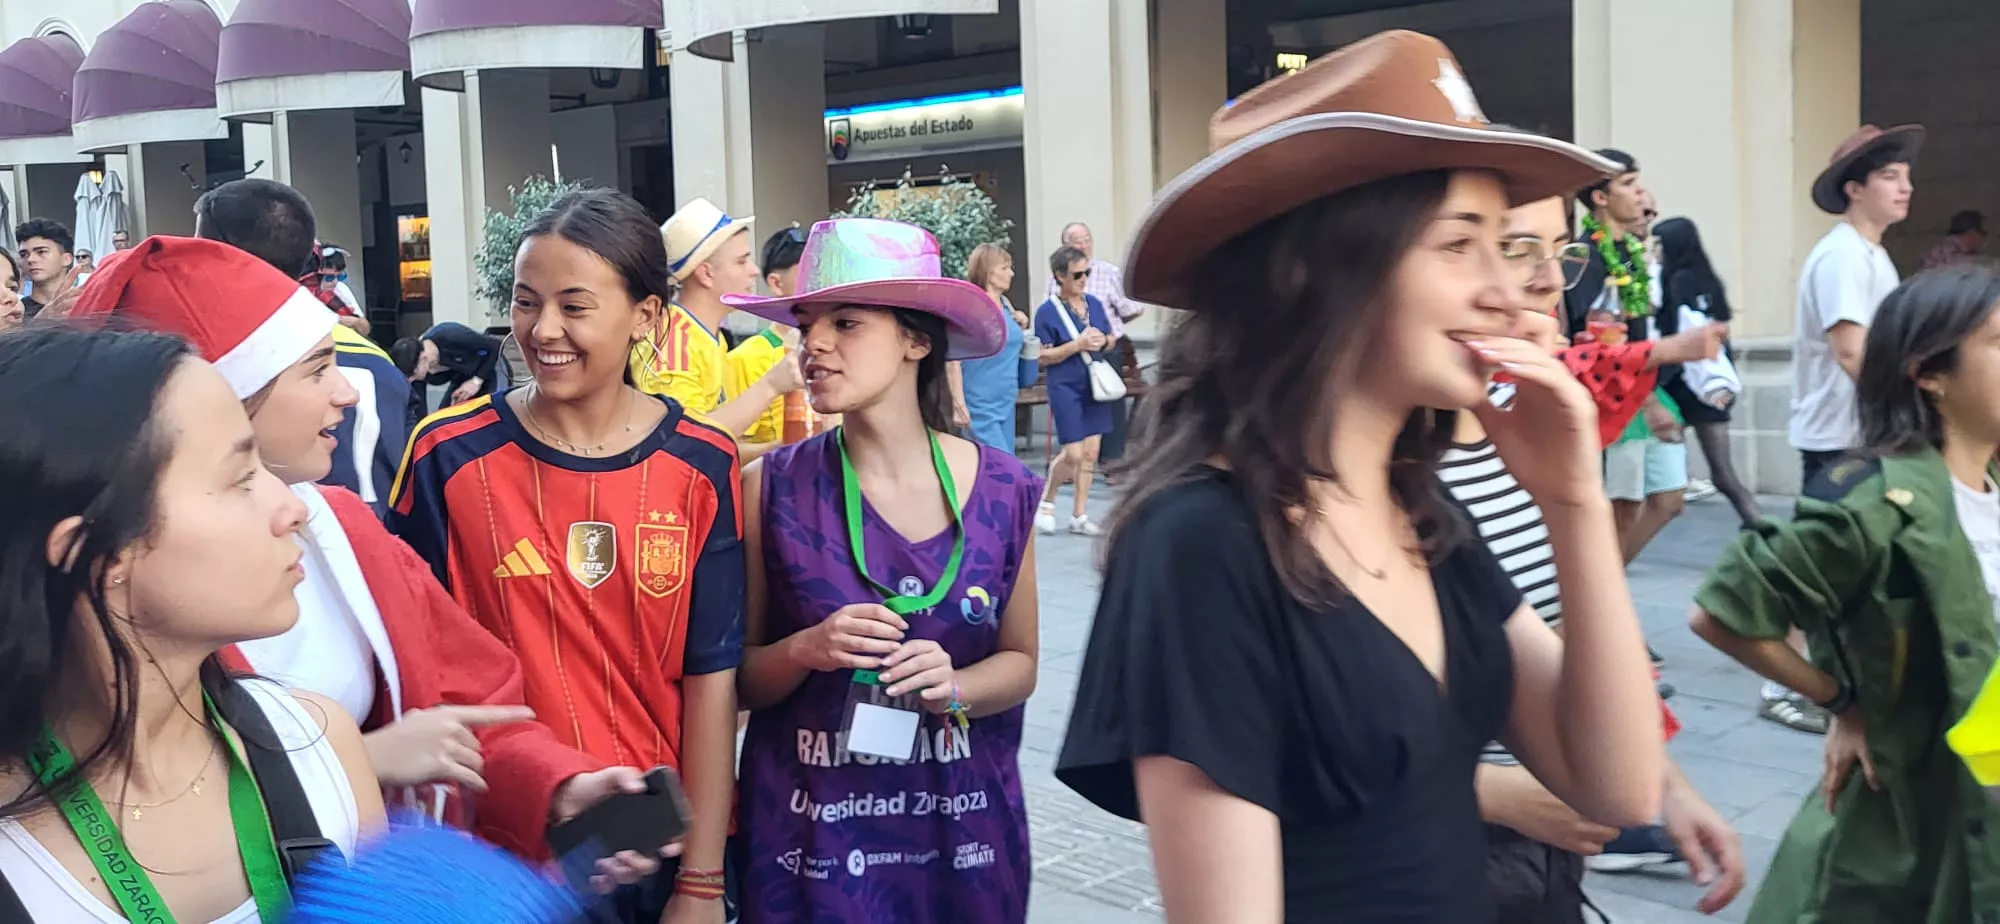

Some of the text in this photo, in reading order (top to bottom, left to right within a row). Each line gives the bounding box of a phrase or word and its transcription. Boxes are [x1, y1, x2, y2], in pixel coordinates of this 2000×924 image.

[854, 115, 974, 143] Apuestas del Estado
